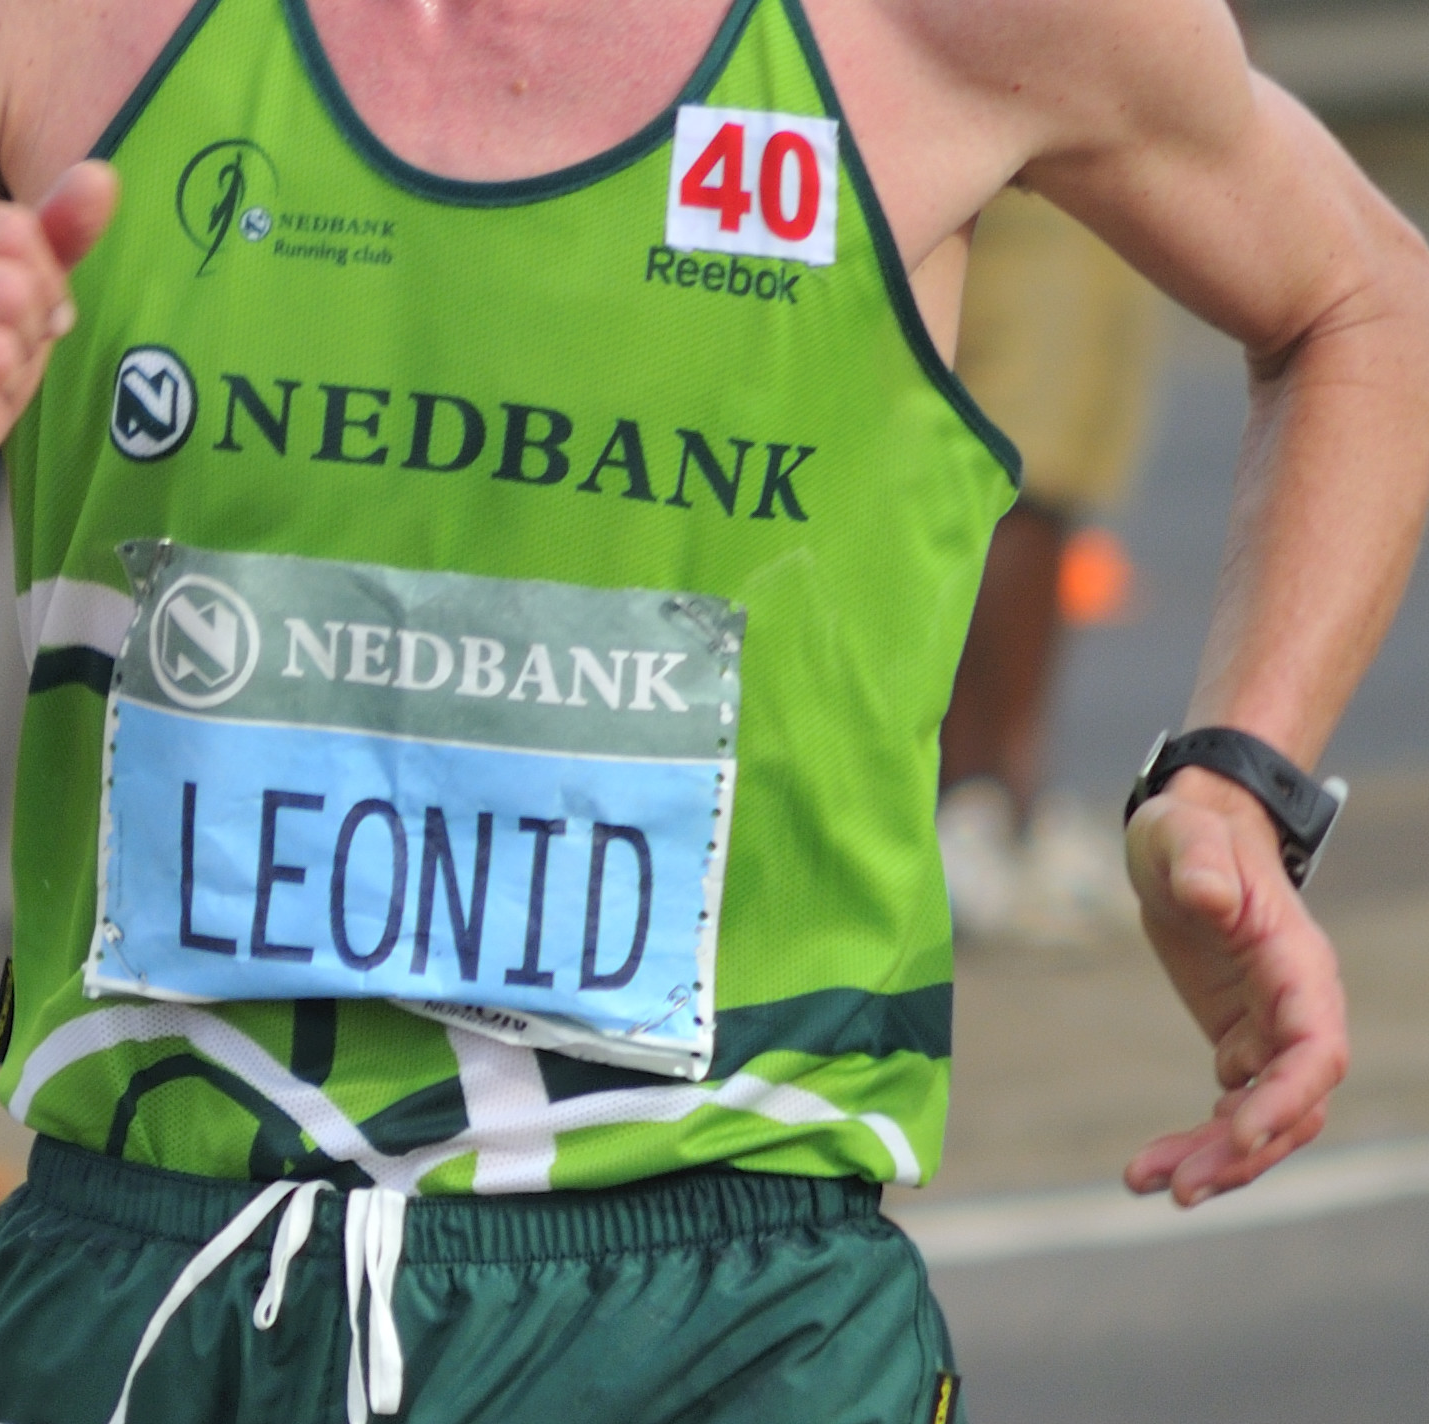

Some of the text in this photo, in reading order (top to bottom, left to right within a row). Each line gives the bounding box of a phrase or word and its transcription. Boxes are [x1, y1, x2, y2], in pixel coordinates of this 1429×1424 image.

[278, 212, 396, 237] NEDBANK
[679, 121, 820, 242] 40
[273, 238, 393, 266] Running club
[645, 245, 801, 304] Reebok
[212, 372, 817, 522] NEDBANK
[281, 617, 689, 713] NEDBANK
[179, 781, 654, 990] LEONID
